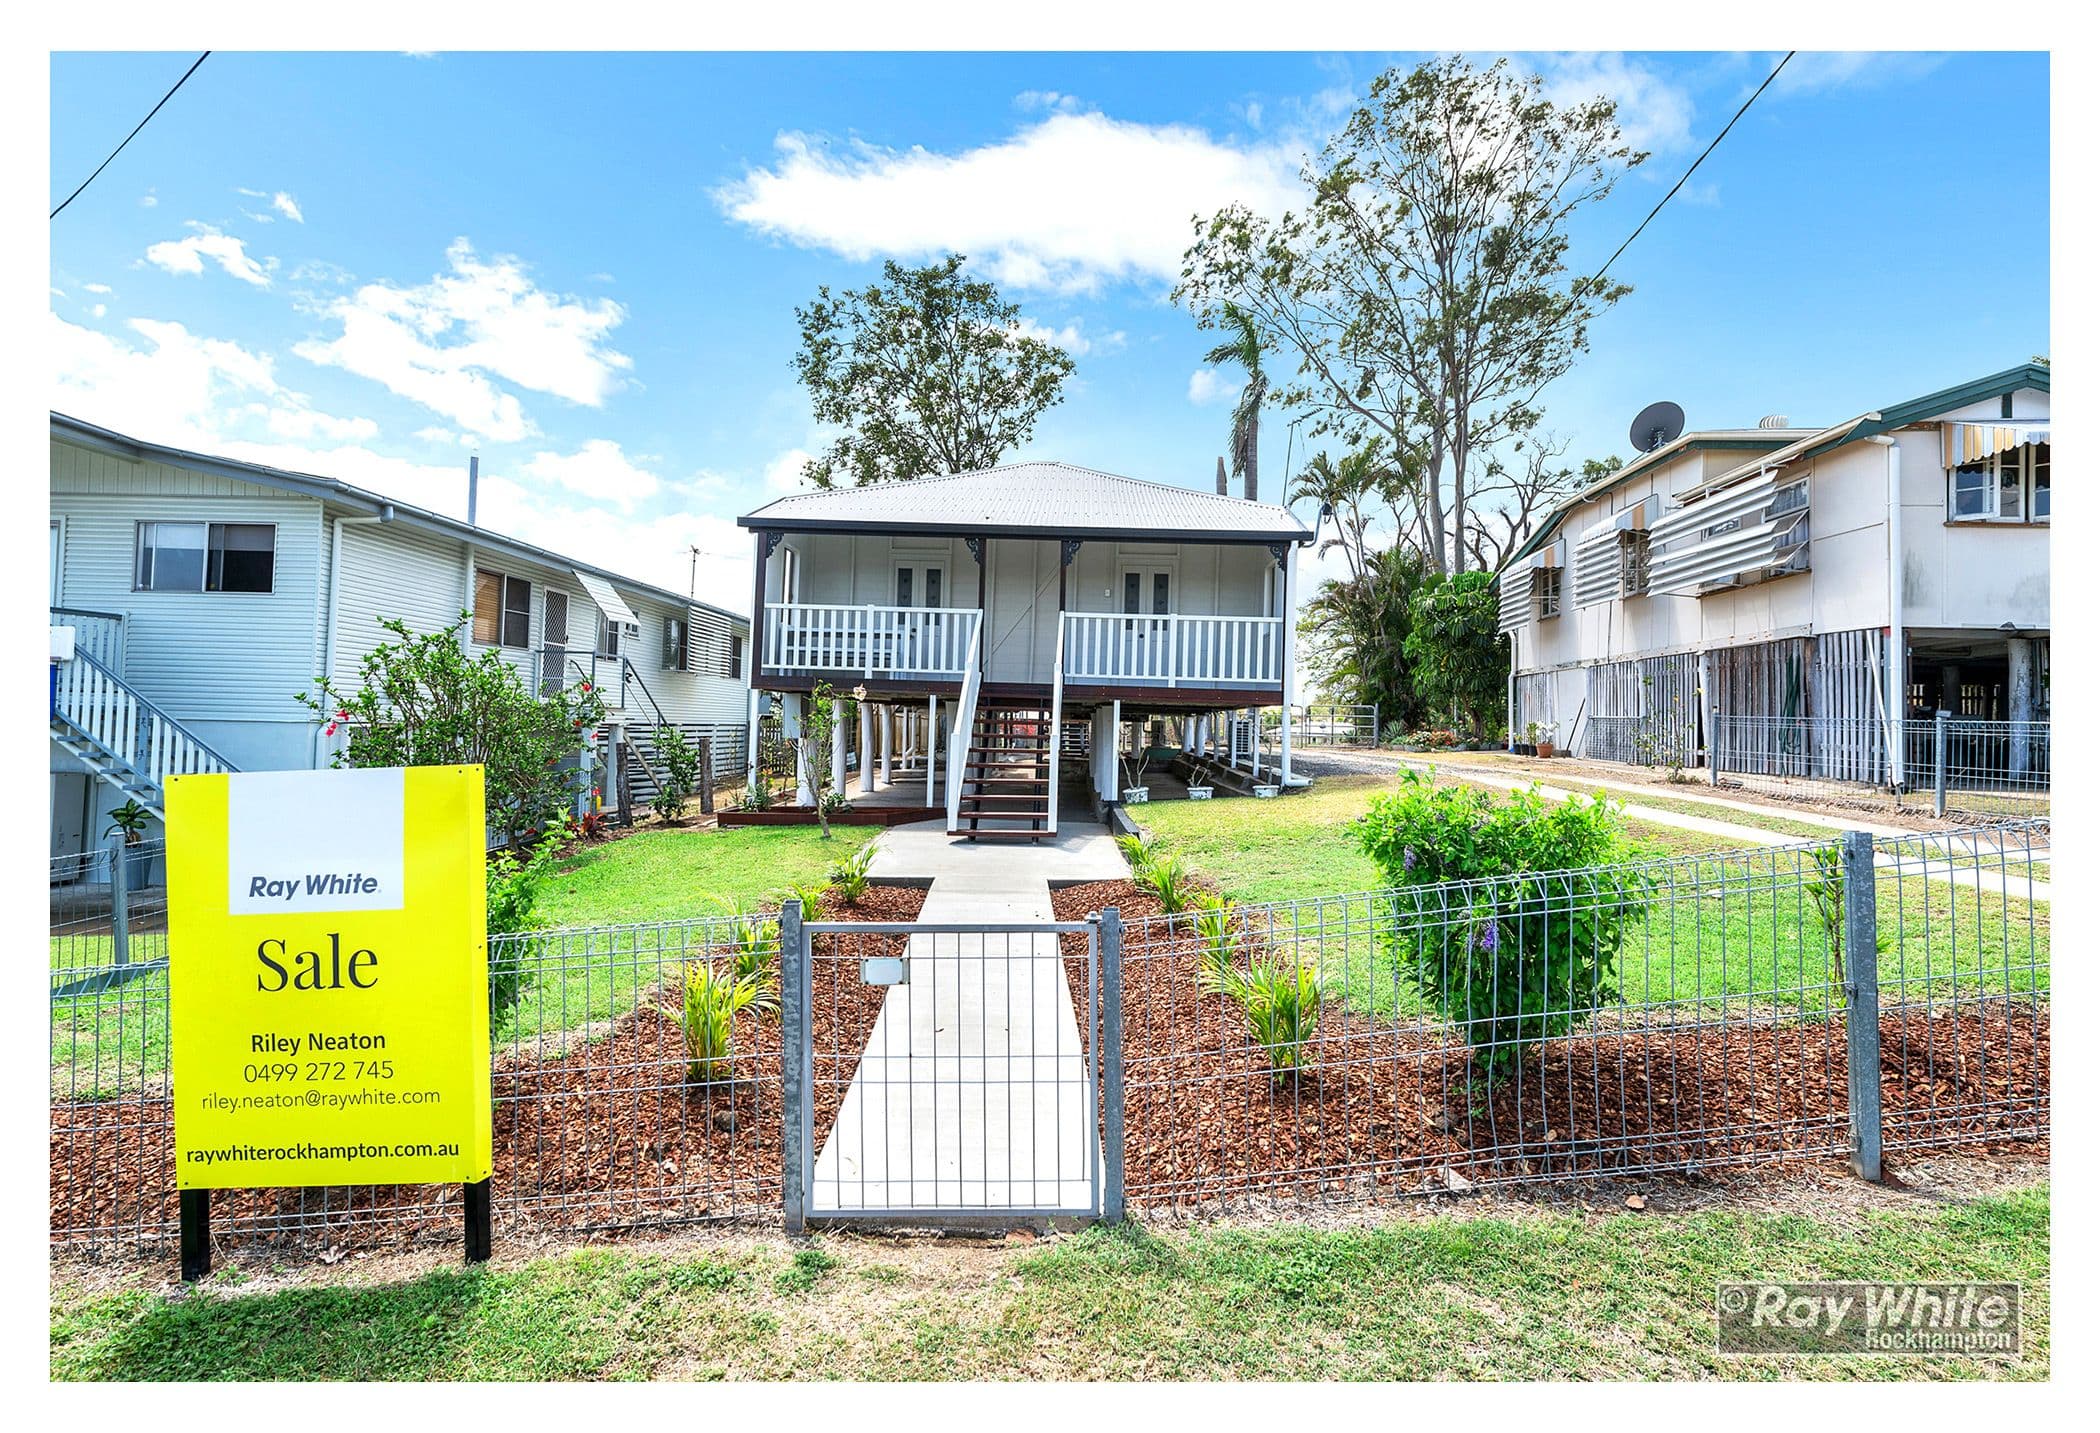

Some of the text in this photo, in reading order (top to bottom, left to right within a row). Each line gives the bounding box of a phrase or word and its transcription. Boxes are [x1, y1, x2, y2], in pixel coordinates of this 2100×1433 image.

[249, 873, 378, 900] Ray White
[257, 933, 378, 992] Sale
[251, 1032, 386, 1056] Riley Neaton
[244, 1060, 394, 1083] 0499 272 745
[202, 1088, 440, 1113] riley.neaton@raywhite.com
[186, 1142, 459, 1166] raywhiterockhampton.com.au
